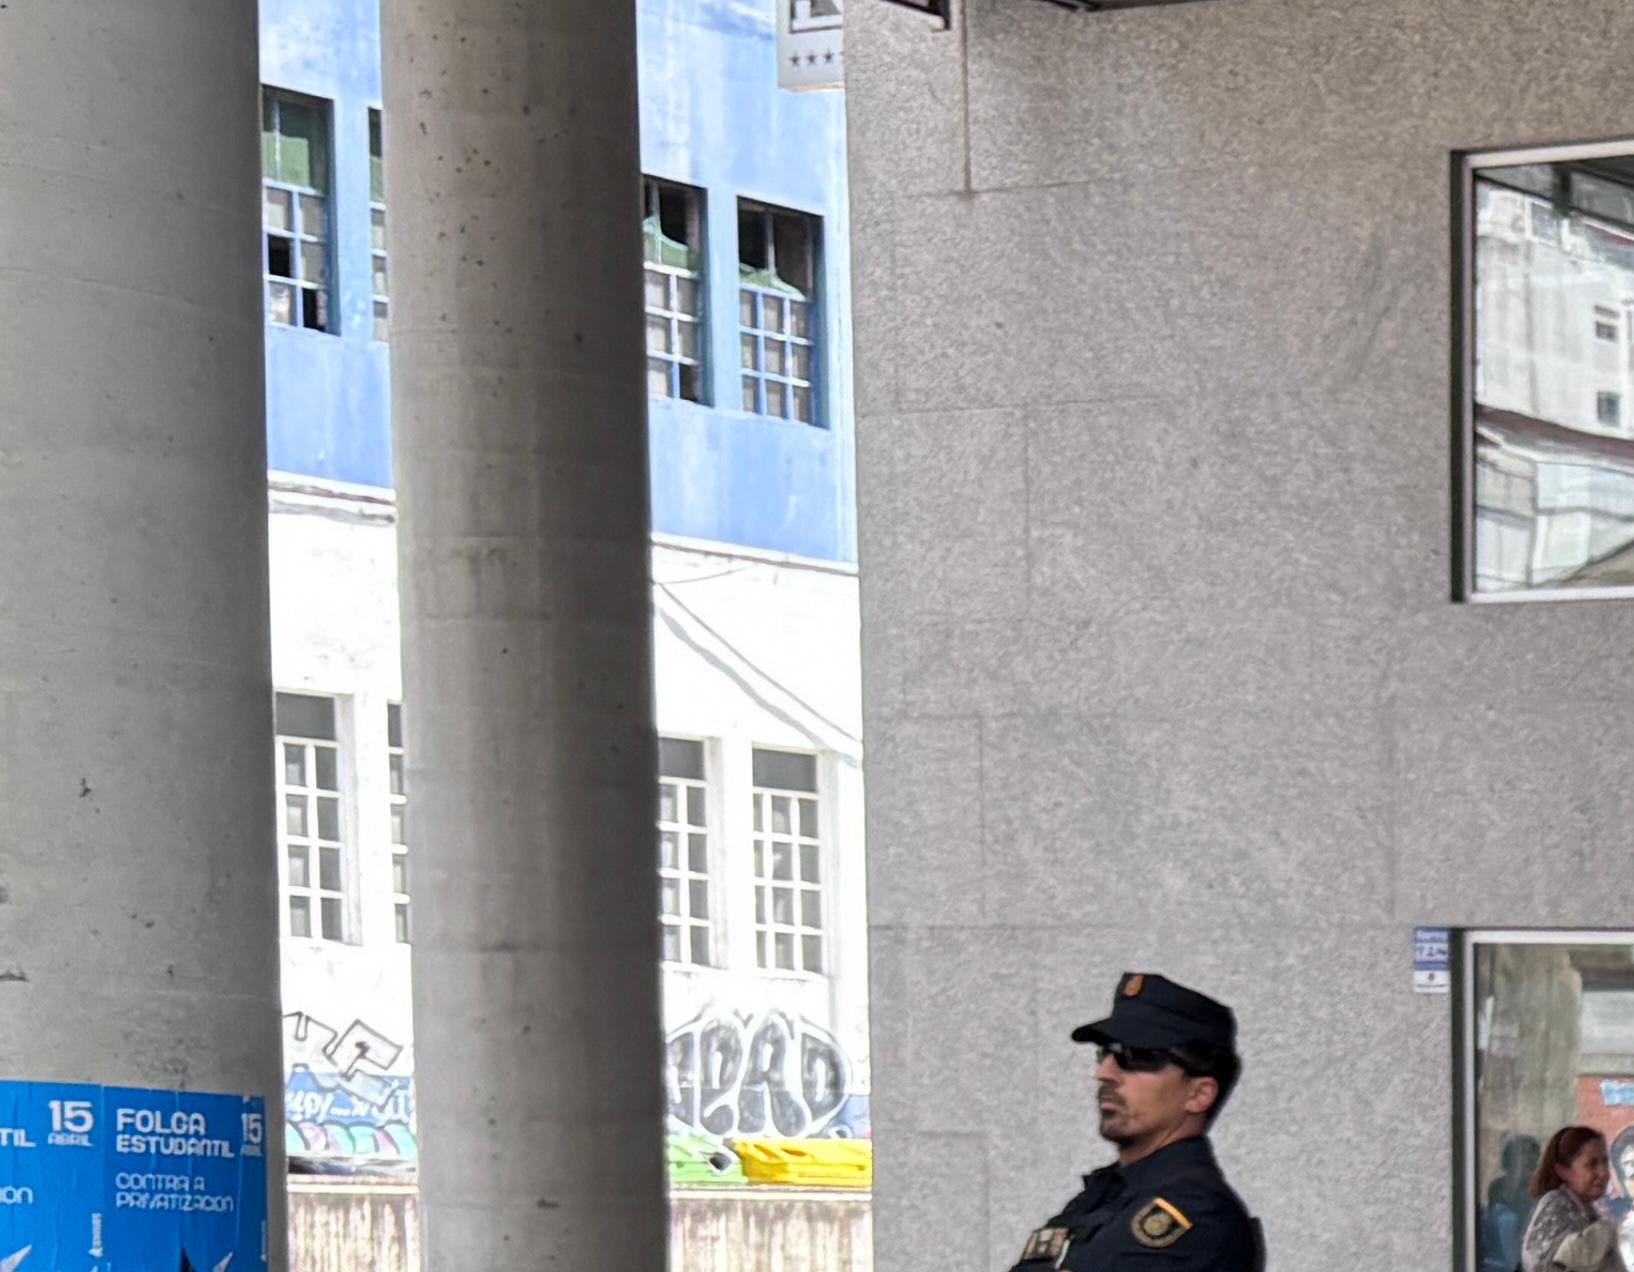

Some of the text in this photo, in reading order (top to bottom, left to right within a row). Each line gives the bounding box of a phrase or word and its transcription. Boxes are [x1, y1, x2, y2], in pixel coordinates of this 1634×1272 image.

[47, 1099, 95, 1133] 15
[116, 1107, 206, 1135] FOLGA
[241, 1112, 262, 1144] 15
[116, 1133, 235, 1158] ESTUDANTIL
[115, 1172, 205, 1191] CONTRA A
